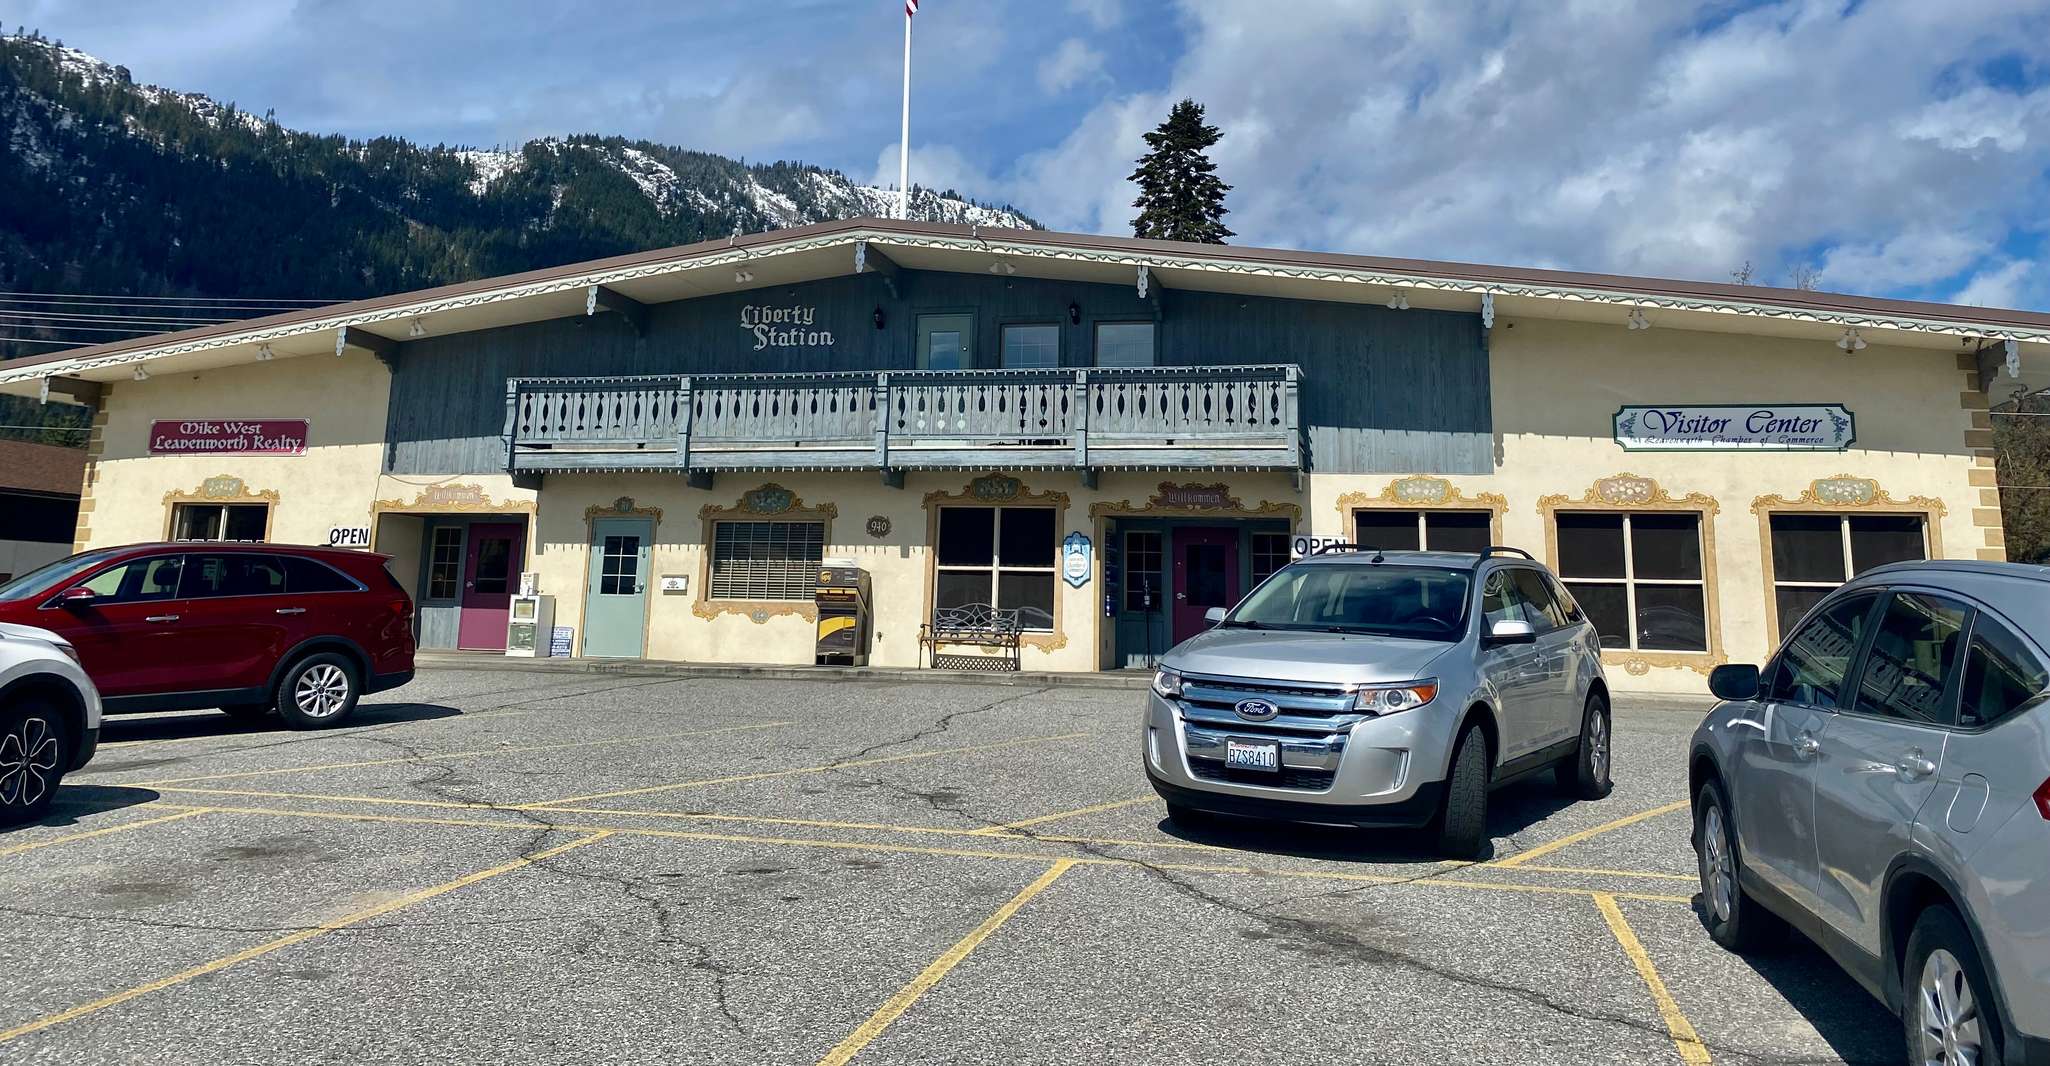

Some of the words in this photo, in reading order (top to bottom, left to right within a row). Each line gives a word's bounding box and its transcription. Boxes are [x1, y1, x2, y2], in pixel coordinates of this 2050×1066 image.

[740, 304, 816, 329] Liberty
[753, 323, 836, 351] Station
[179, 422, 220, 435] Mike
[223, 422, 262, 434] West
[1643, 409, 1732, 434] Visitor
[1745, 410, 1823, 434] Center
[154, 435, 248, 450] Leavenworth
[252, 434, 302, 453] Realty
[1778, 434, 1825, 445] Commerce
[330, 528, 369, 544] OPEN
[1243, 702, 1266, 714] Ford
